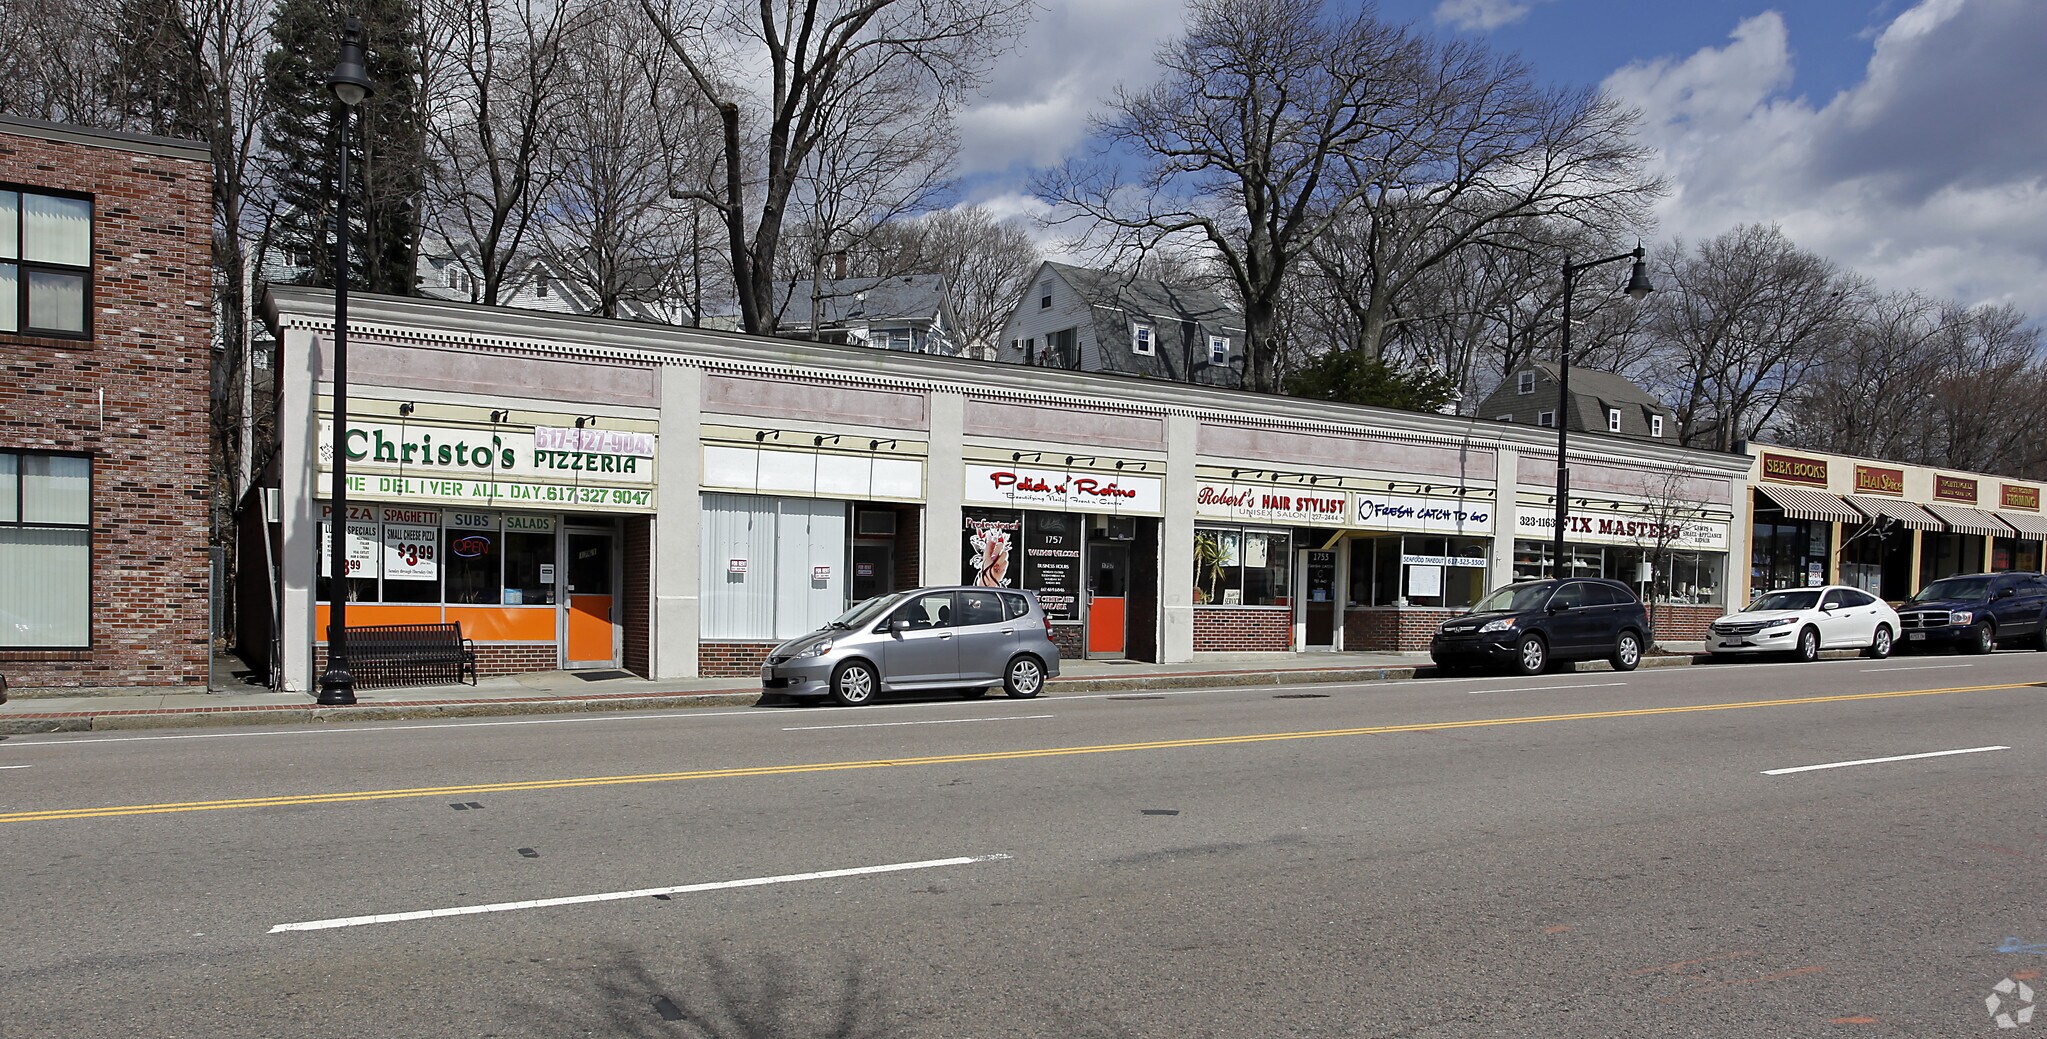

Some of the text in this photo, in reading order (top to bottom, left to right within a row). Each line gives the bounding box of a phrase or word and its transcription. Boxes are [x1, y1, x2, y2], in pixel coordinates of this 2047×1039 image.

[345, 428, 515, 469] Christo's
[537, 427, 652, 455] 617-327-904
[534, 450, 636, 473] PIZZERIA
[1766, 459, 1826, 479] SEEK BOOKS
[379, 477, 463, 497] DELIVER
[472, 482, 504, 498] ALL
[580, 488, 609, 503] 327
[612, 491, 650, 505] 9047
[990, 471, 1050, 493] Polish
[1074, 478, 1136, 498] Refine
[1197, 486, 1345, 514] Robert's HAIR STYLIST
[2006, 493, 2036, 507] FRAMING
[322, 505, 373, 520] PZA
[384, 509, 438, 524] SPAGHETTI
[455, 514, 489, 527] SUBS
[1239, 508, 1307, 519] UNISEX SALON
[1375, 503, 1488, 523] FRESH CATCH TO GO
[347, 526, 376, 536] SPECIALS
[507, 517, 550, 530] SALADS
[1519, 515, 1681, 540] 323-1163 FIX MASTERS
[387, 528, 435, 542] SMALL CHEESE PIZZA
[1045, 535, 1062, 544] 1757
[452, 539, 489, 555] OPEN
